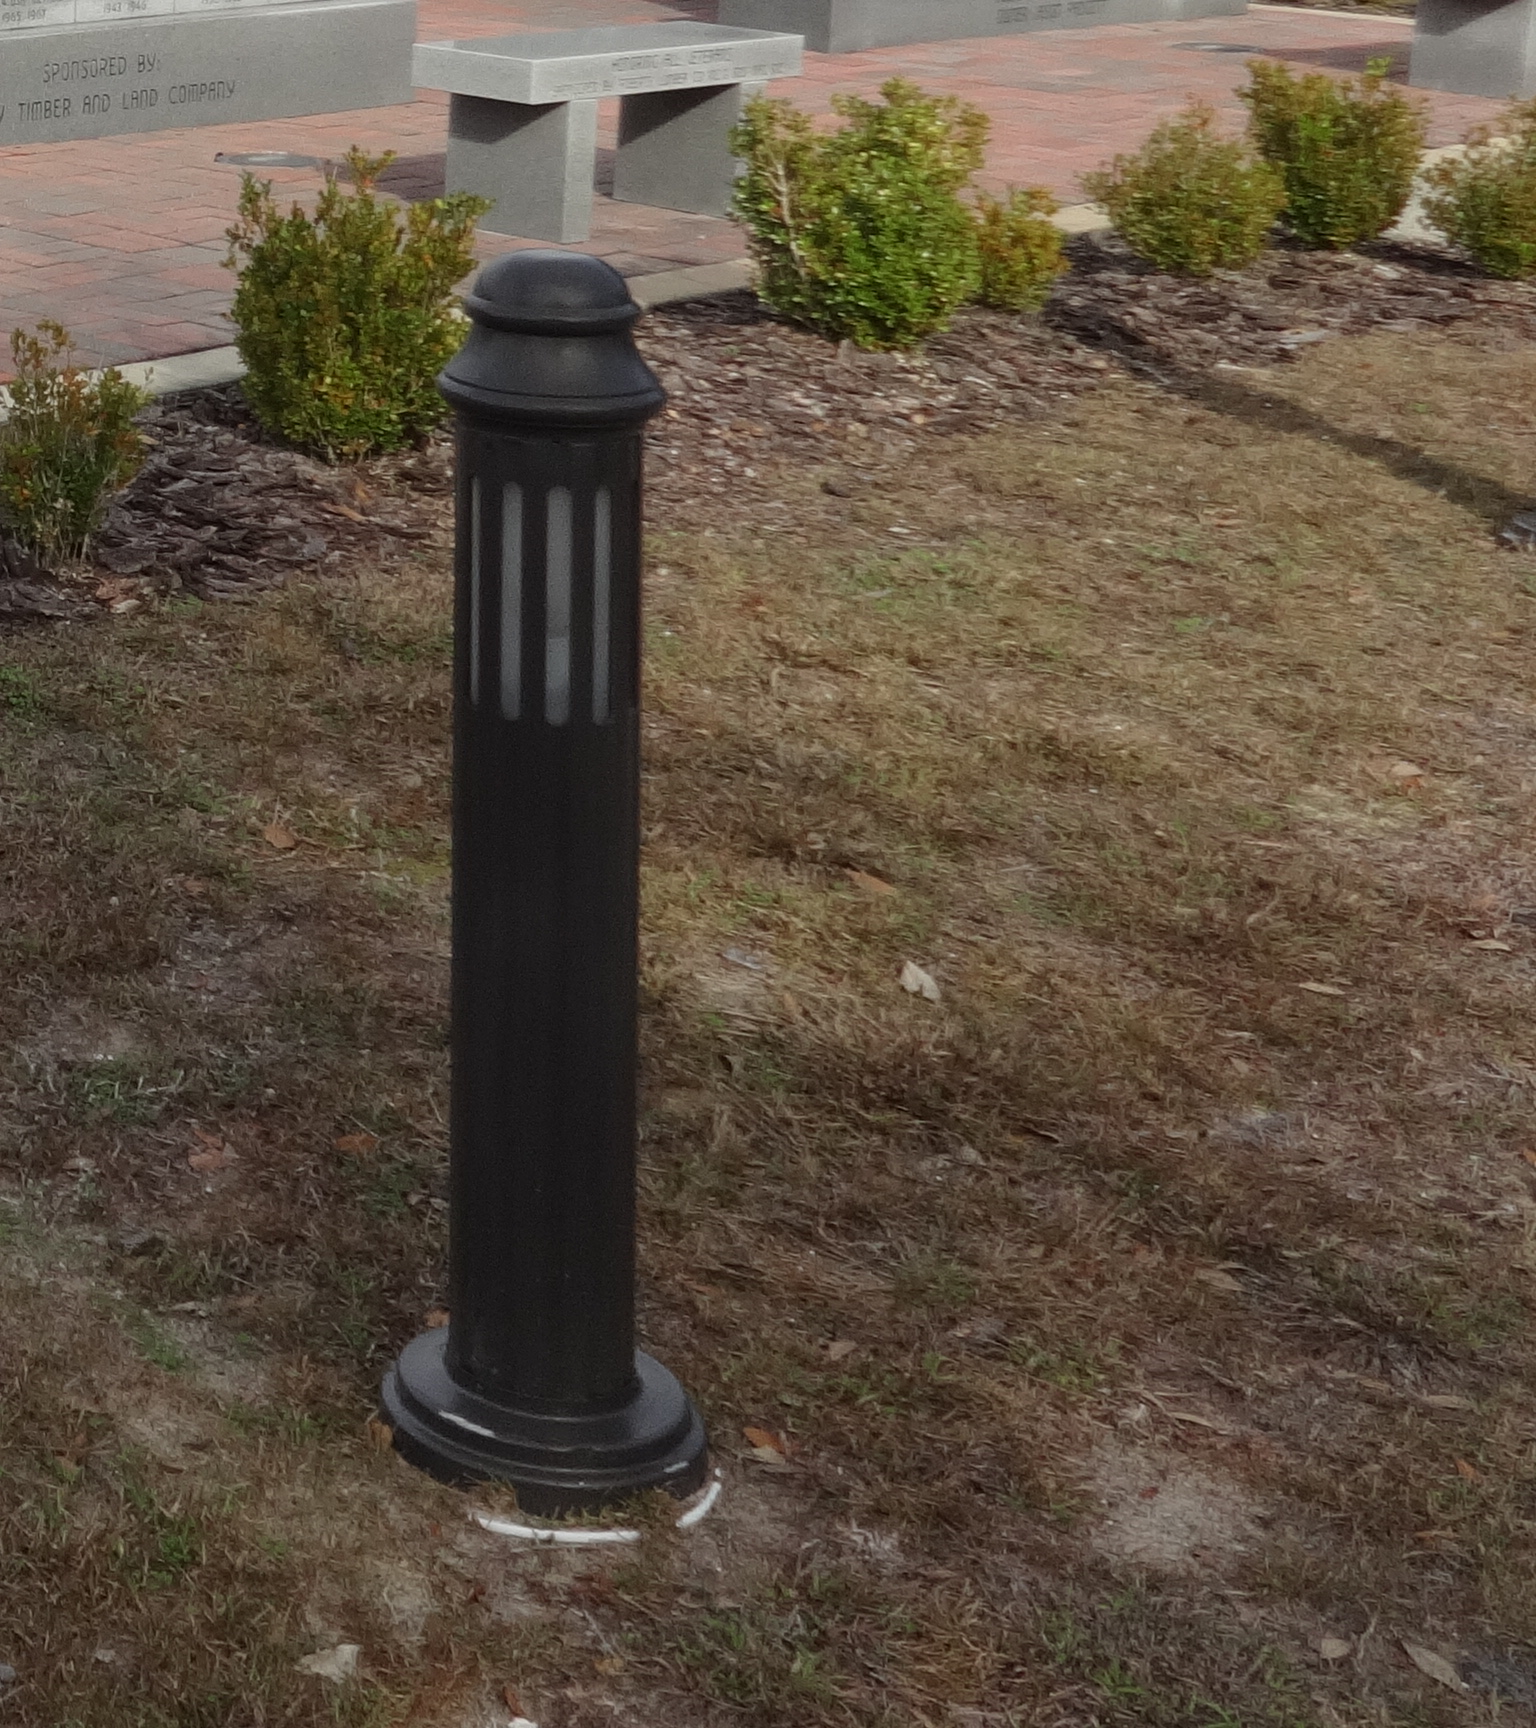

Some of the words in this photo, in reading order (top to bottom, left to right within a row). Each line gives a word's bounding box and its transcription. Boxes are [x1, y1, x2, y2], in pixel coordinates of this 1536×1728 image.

[42, 56, 127, 84] SPONSORED
[18, 98, 71, 122] TIMBER
[82, 93, 111, 116] AND
[122, 88, 158, 110] LAND
[168, 80, 236, 106] COMPANY
